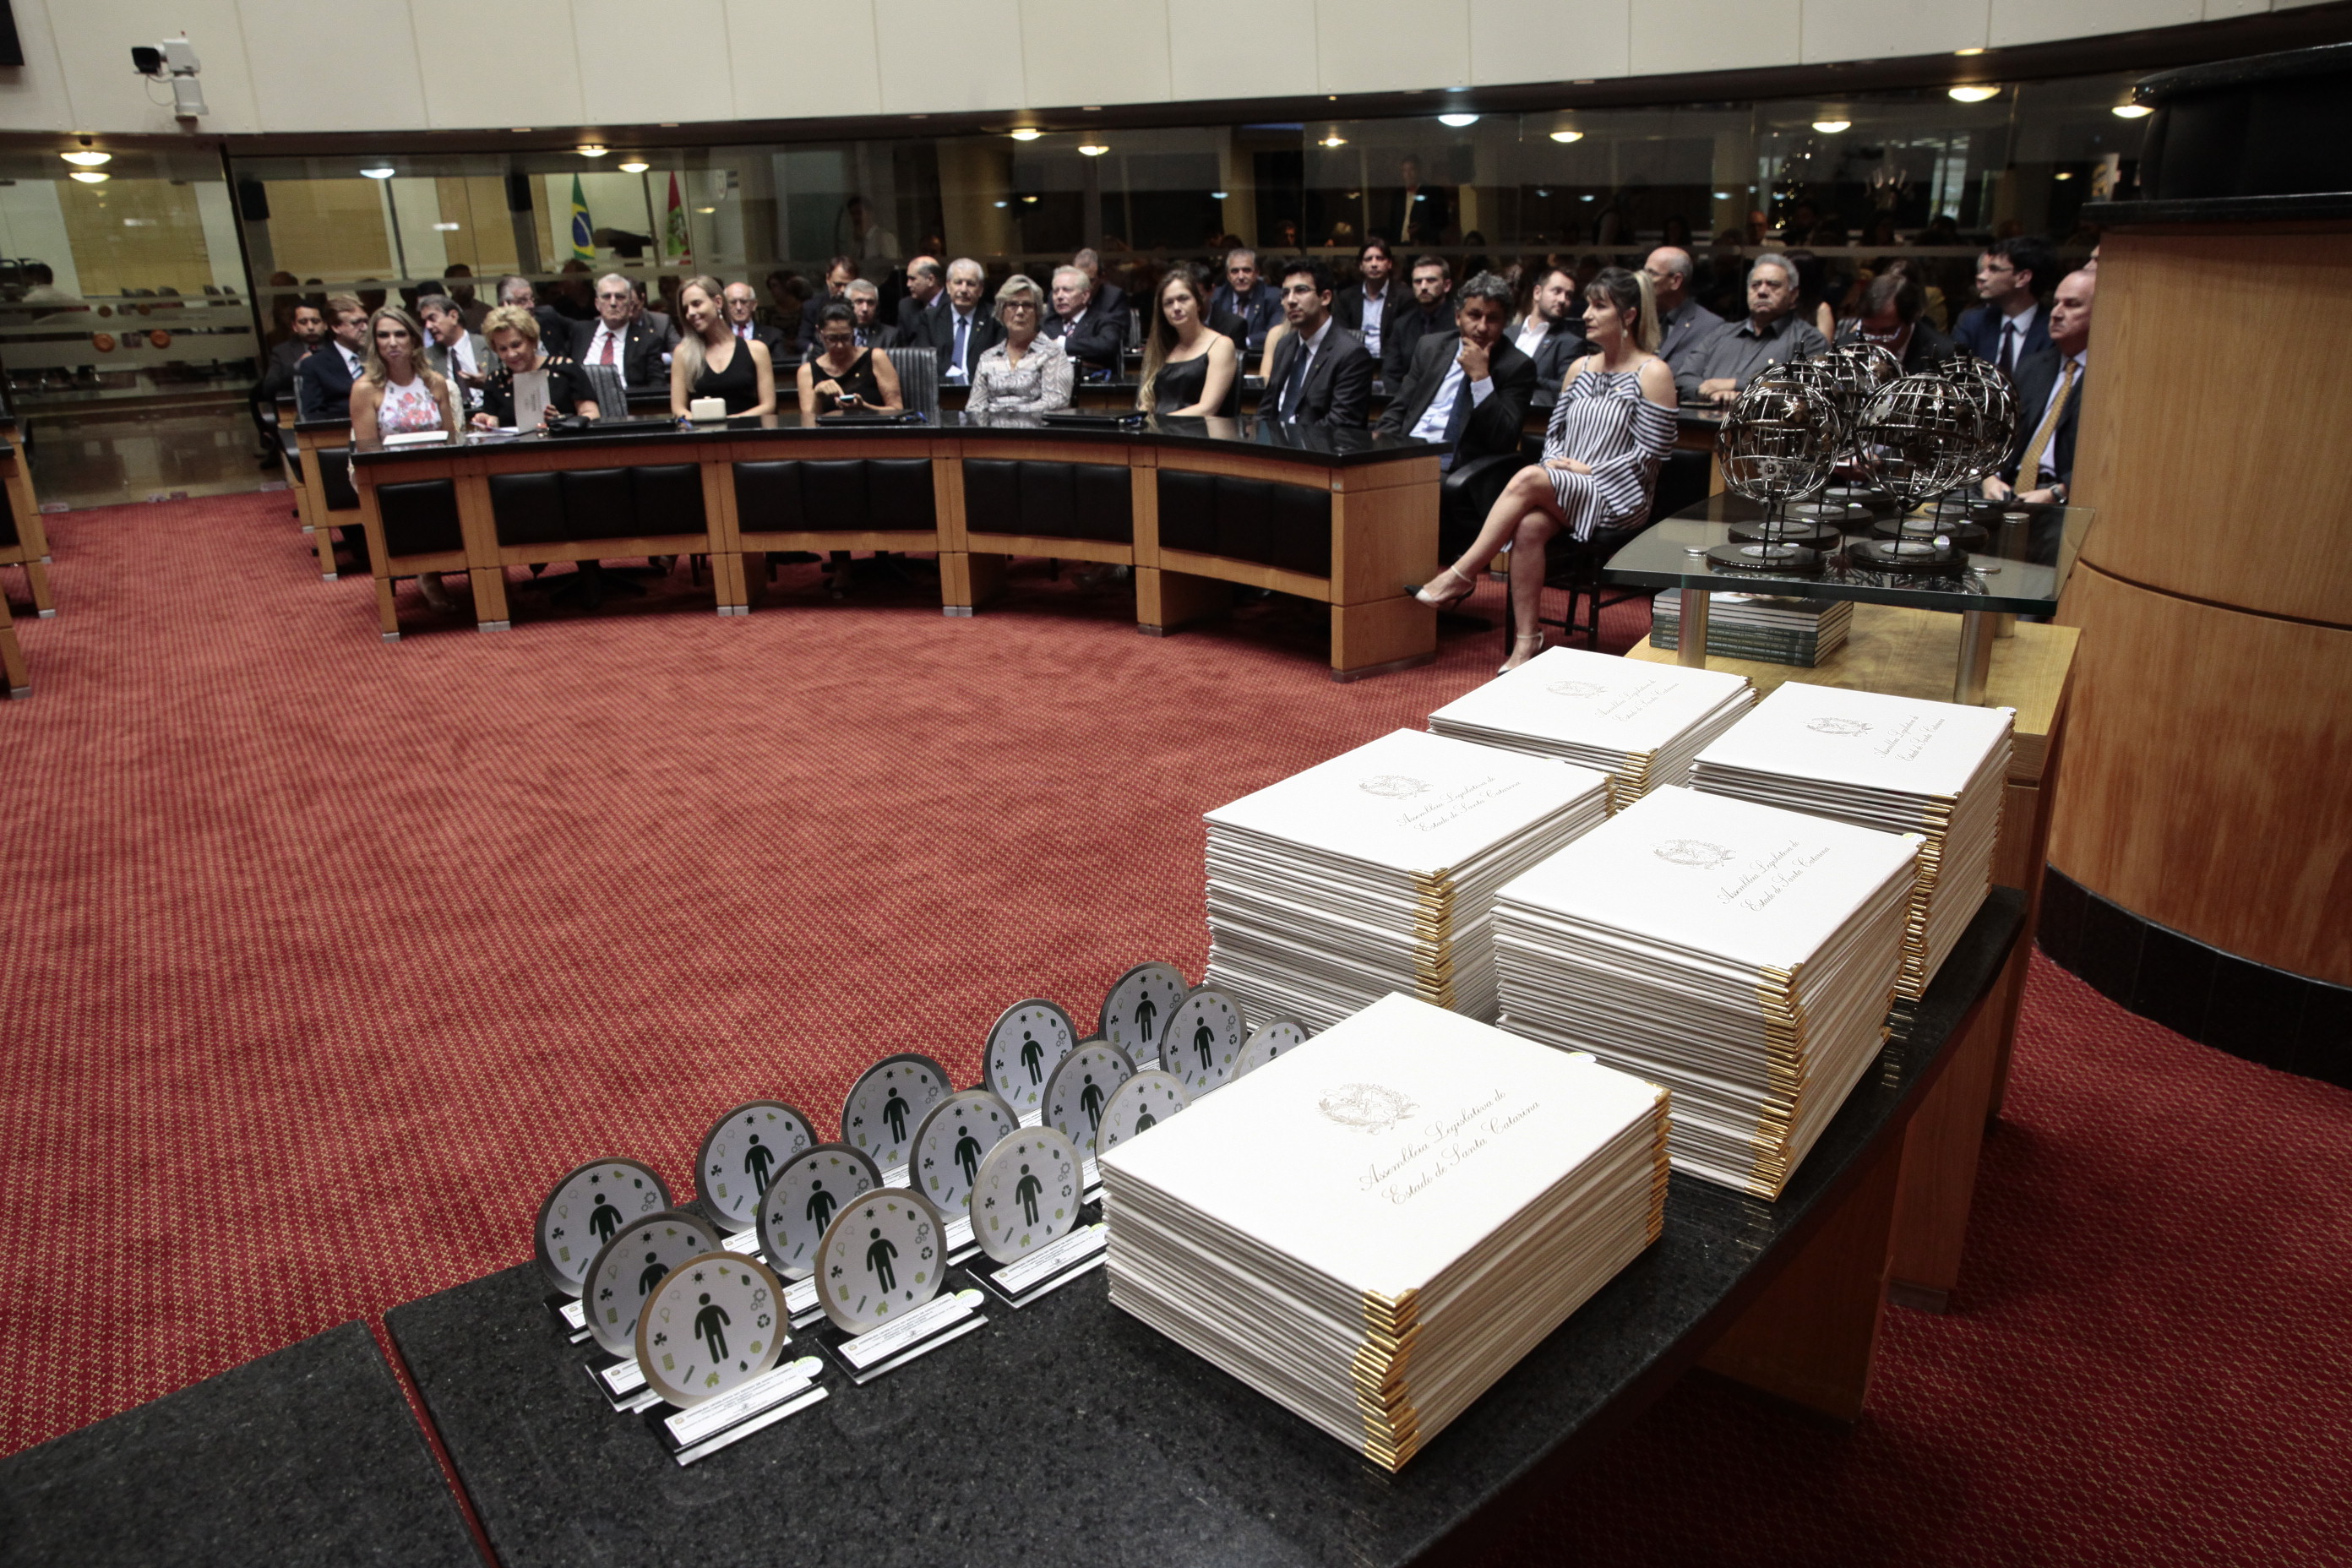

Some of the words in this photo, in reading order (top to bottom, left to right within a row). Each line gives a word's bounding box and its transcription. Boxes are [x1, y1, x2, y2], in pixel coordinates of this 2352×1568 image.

[1413, 816, 1449, 831] Estado
[1453, 798, 1485, 813] Santa
[1740, 890, 1775, 912] Estado
[1771, 869, 1803, 887] Santa
[1792, 847, 1831, 868] Catarina
[1358, 1142, 1429, 1191] Assembleia
[1424, 1100, 1494, 1144] Legislativa
[1494, 1088, 1506, 1102] do
[1381, 1172, 1433, 1205] Estado
[1435, 1162, 1447, 1177] de
[1441, 1138, 1487, 1166] Santa
[1480, 1101, 1540, 1135] Catarina
